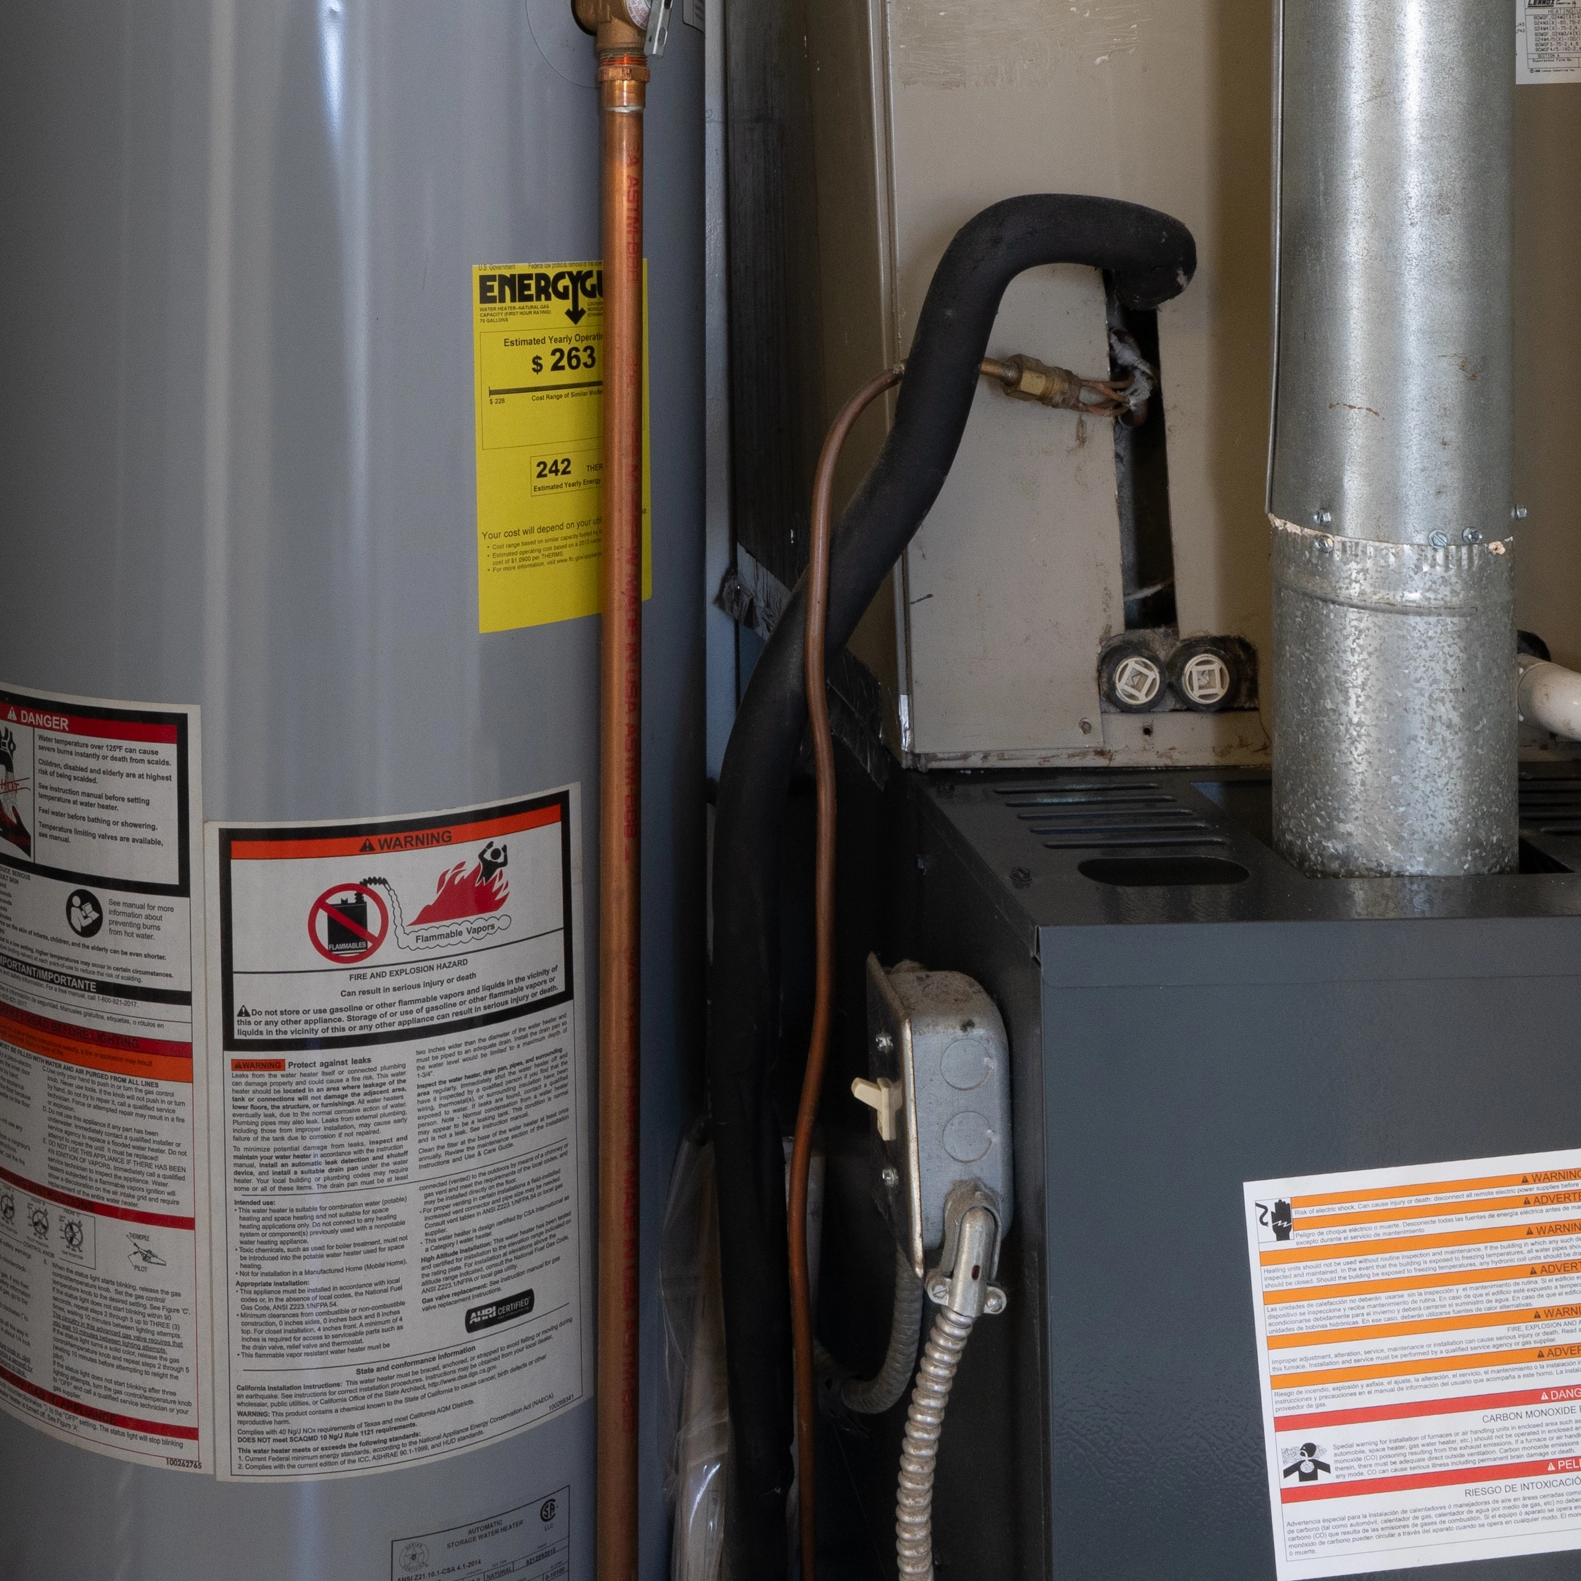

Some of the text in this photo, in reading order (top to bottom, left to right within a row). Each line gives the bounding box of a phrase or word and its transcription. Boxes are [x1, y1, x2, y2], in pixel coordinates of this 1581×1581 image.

[503, 336, 546, 346] Estimated
[547, 334, 572, 344] Yearly
[531, 345, 596, 375] $ 263
[570, 390, 588, 398] Similar
[536, 458, 571, 478] 242
[533, 475, 602, 492] Estimated Yearly Energy
[482, 519, 591, 540] Your cost will depend on your
[20, 710, 68, 730] DANGER
[37, 734, 53, 742] Water
[54, 738, 89, 748] temperature
[105, 744, 123, 752] 125°F
[38, 744, 55, 752] severe
[56, 747, 73, 756] burns
[74, 750, 100, 760] instantly
[109, 754, 128, 762] death
[129, 756, 145, 764] from
[146, 758, 171, 766] scalds.
[1, 779, 19, 793] HOT
[377, 830, 452, 850] WARNING
[108, 898, 121, 906] See
[122, 901, 145, 909] manual
[146, 903, 156, 911] for
[108, 909, 163, 921] information about
[108, 919, 161, 931] preventing burns
[415, 923, 497, 943] Flammable Vapors
[123, 929, 134, 937] hot
[135, 932, 154, 940] water.
[328, 941, 366, 950] FLAMMABLES
[349, 958, 468, 981] FIRE AND EXPLOSION HAZARD
[251, 1008, 262, 1016] Do
[329, 1004, 363, 1015] gasoline
[375, 1001, 396, 1009] other
[397, 995, 437, 1006] flammable
[439, 990, 464, 1000] vapors
[466, 985, 480, 995] and
[481, 981, 505, 991] liquids
[526, 967, 550, 980] vicinity
[551, 964, 558, 973] of
[340, 989, 356, 997] Can
[358, 987, 381, 995] result
[392, 983, 421, 992] serious
[422, 979, 444, 988] injury
[455, 972, 476, 982] death
[91, 1030, 140, 1049] LIGHTING
[242, 1061, 282, 1070] WARNING
[319, 1059, 348, 1068] against
[351, 1056, 371, 1064] leaks
[497, 1298, 529, 1315] CERTIFIED
[1524, 1321, 1562, 1330] EXPLOSION
[355, 1345, 475, 1375] State and conformance information
[61, 1400, 117, 1424] APPLIANCE
[1482, 1411, 1522, 1423] CARBON
[1525, 1405, 1576, 1418] MONOXIDE
[165, 1457, 202, 1469] 100262765
[1464, 1485, 1502, 1496] RIESGO
[1504, 1483, 1517, 1493] DE
[446, 1535, 476, 1548] STORAGE
[499, 1519, 523, 1532] HEATER
[467, 1519, 502, 1535] AUTOMATIC
